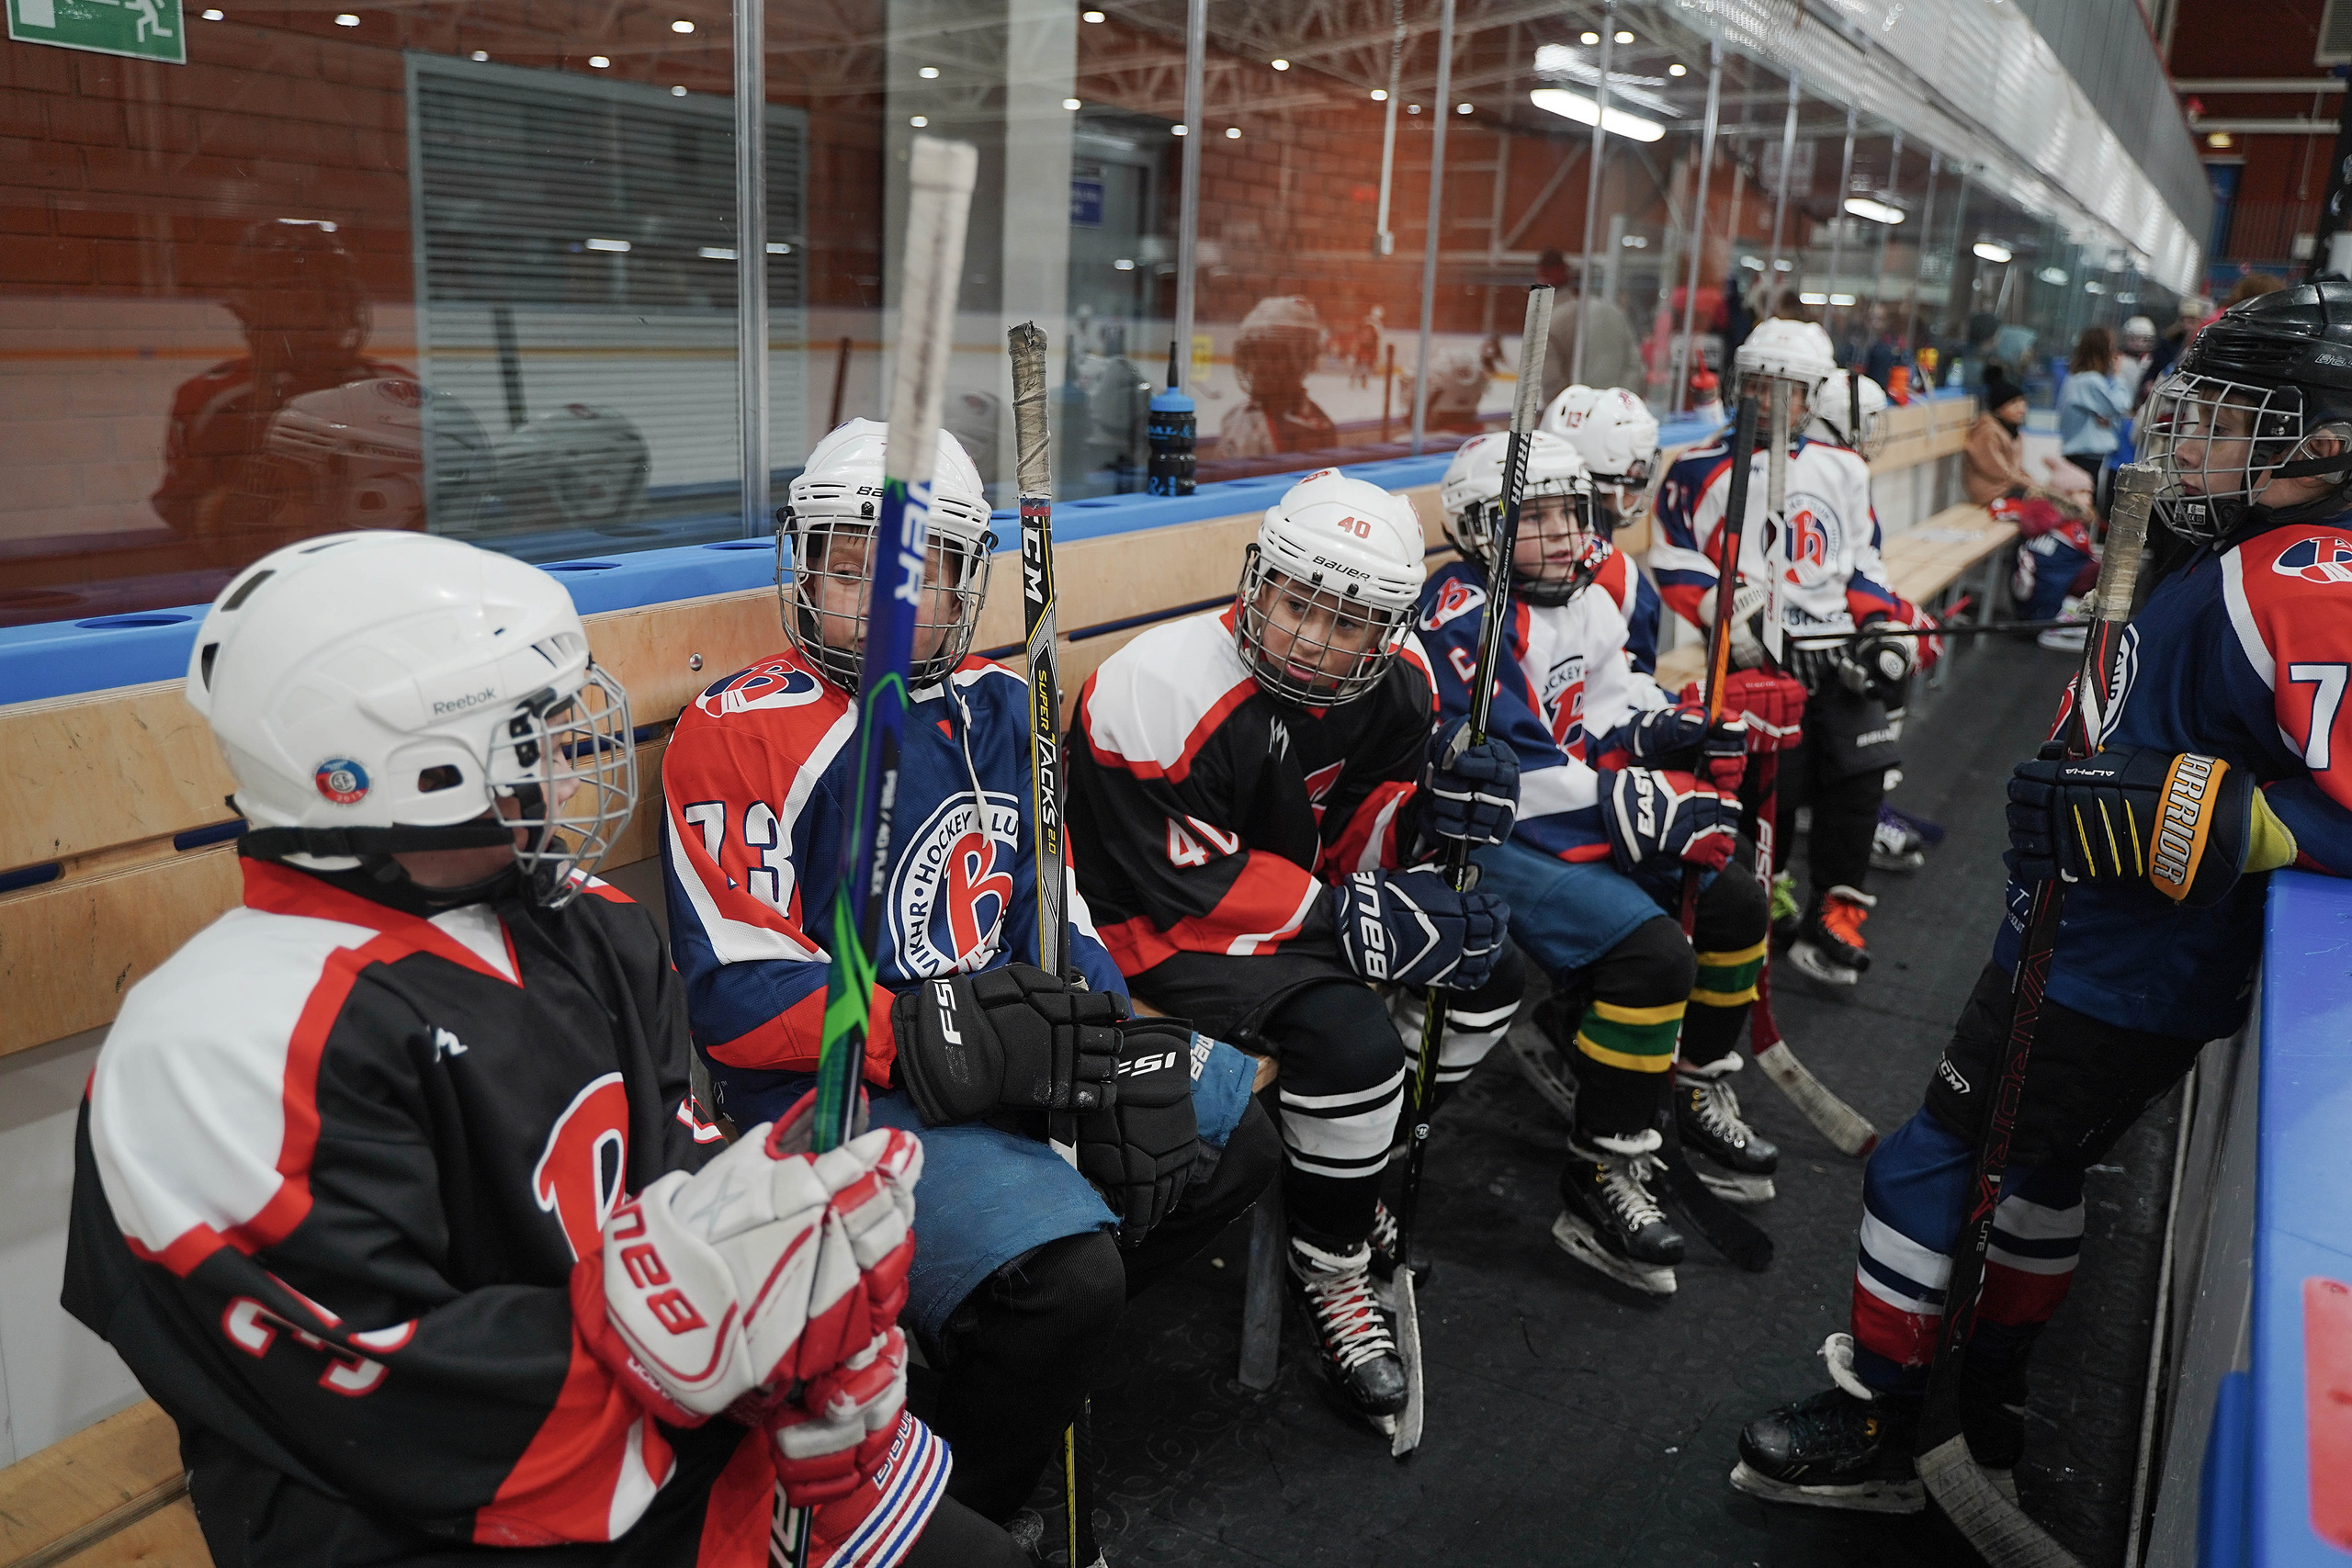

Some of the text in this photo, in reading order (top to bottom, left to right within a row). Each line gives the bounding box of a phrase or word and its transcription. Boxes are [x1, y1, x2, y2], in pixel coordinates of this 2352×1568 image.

[1338, 516, 1372, 540] 40
[1312, 555, 1371, 582] BAUER
[433, 687, 497, 716] Reebok
[1033, 669, 1059, 855] SUPER TACKS 2.0
[2064, 767, 2116, 778] ALPHA
[683, 800, 797, 919] 73
[914, 810, 973, 886] HOCKEY
[910, 901, 941, 977] VIKHR
[1976, 1219, 1991, 1252] LITE
